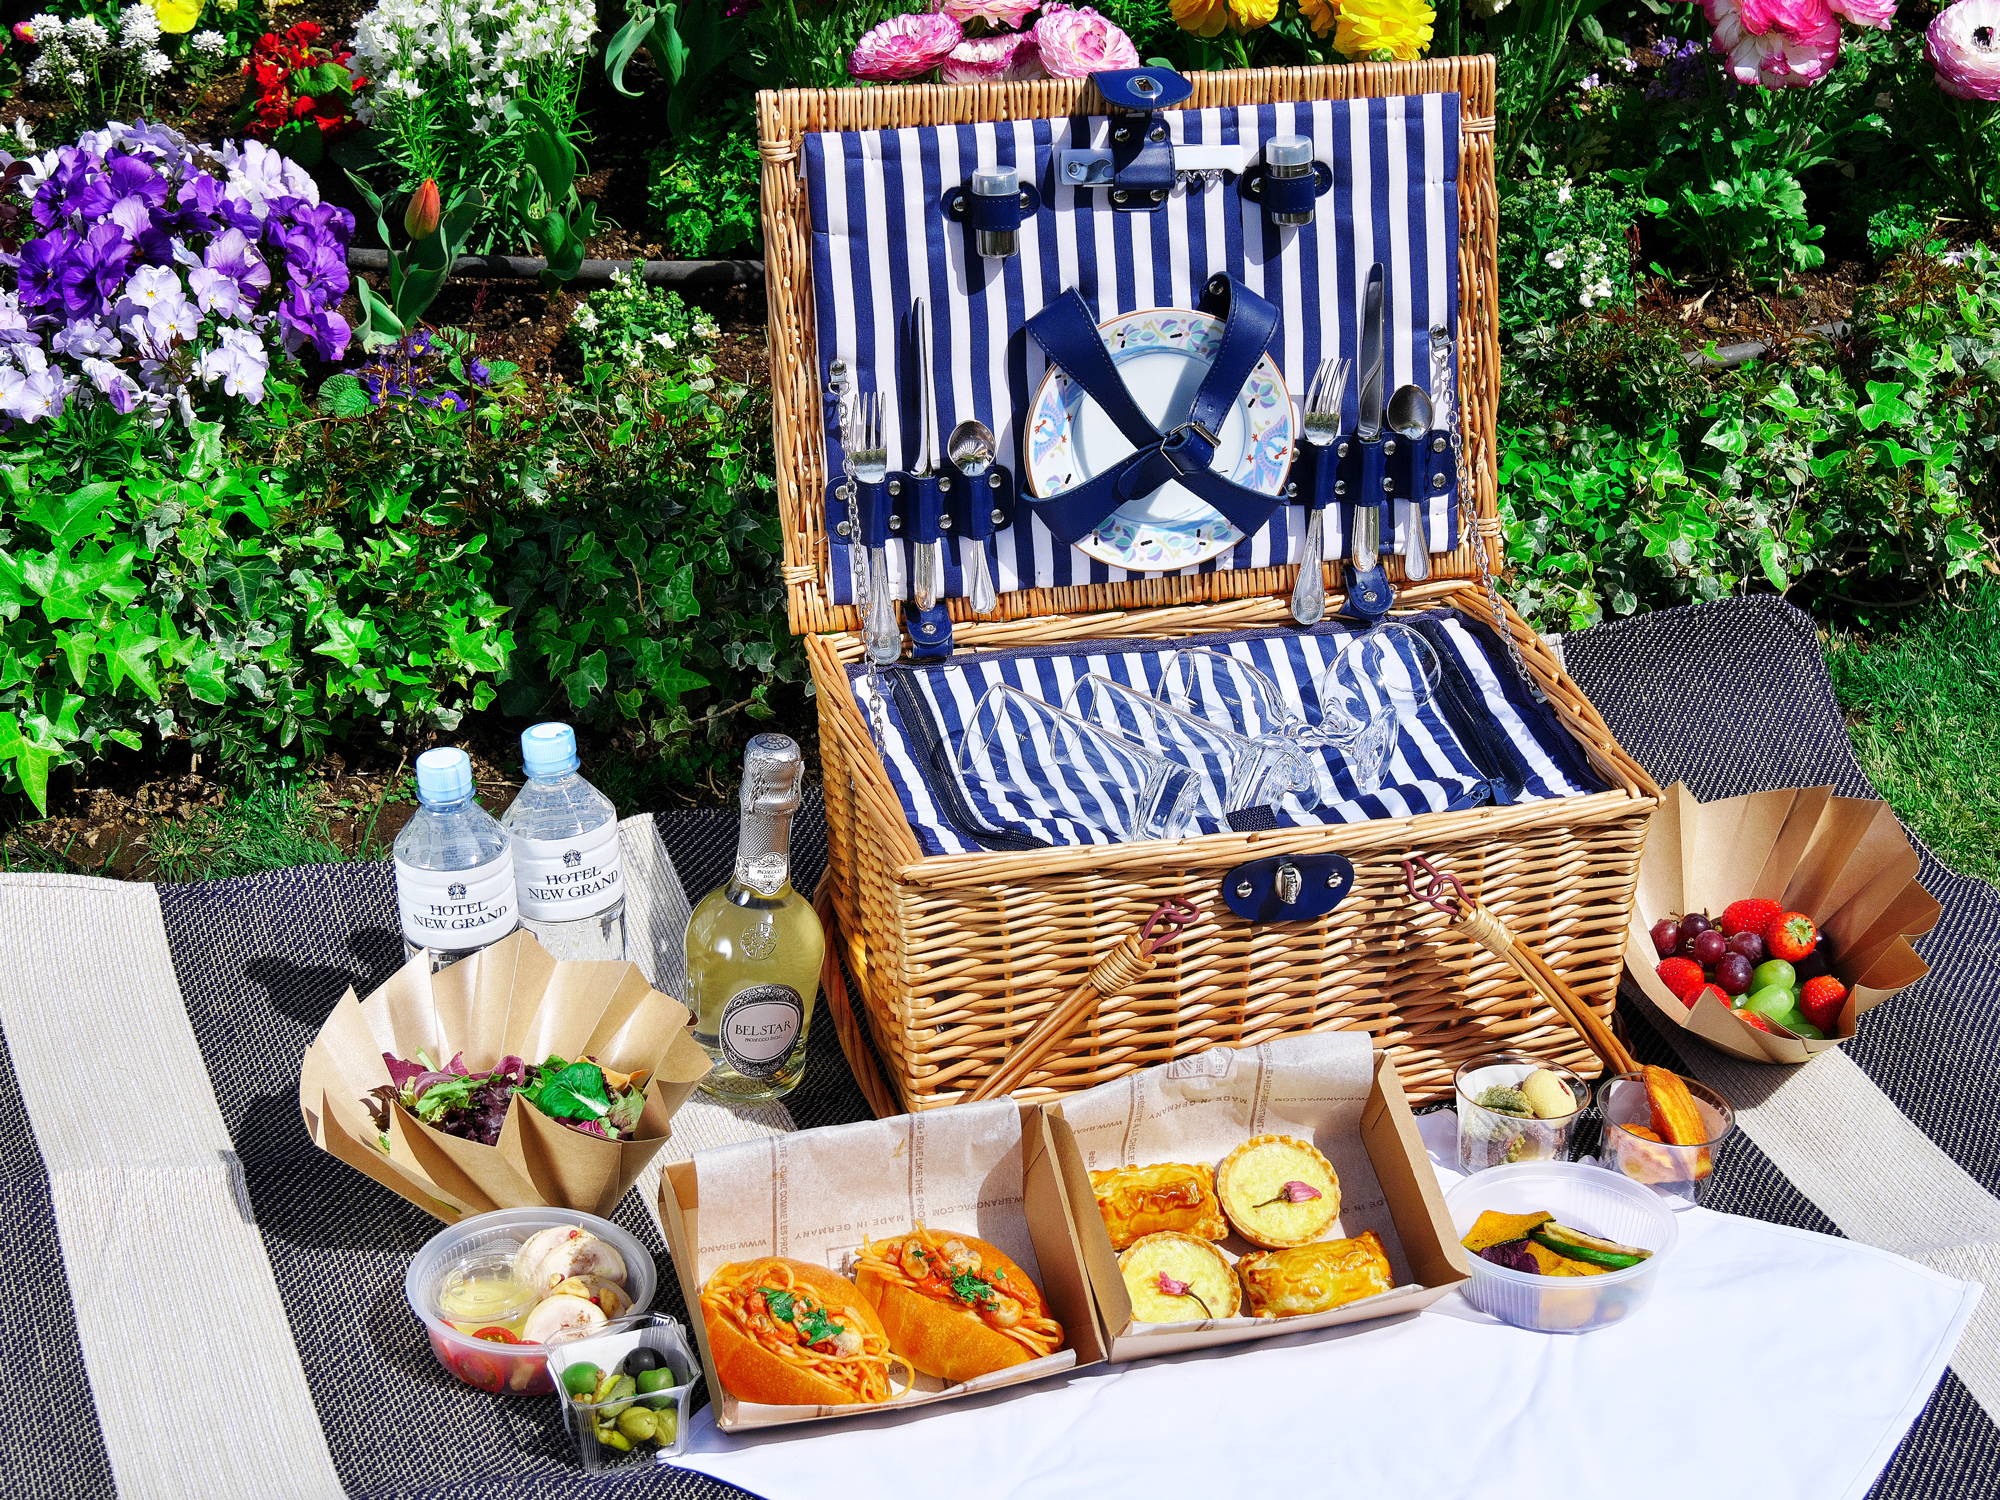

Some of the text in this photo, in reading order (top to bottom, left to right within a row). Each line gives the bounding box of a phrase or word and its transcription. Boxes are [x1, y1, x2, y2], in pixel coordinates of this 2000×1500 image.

[527, 868, 619, 901] NEW GRAND
[545, 865, 602, 886] HOTEL
[413, 904, 508, 930] NEW GRAND
[429, 900, 489, 917] HOTEL
[735, 1020, 792, 1036] BELSTAR
[1147, 1099, 1196, 1120] GERMANY
[1215, 1095, 1248, 1105] MADE
[915, 1135, 924, 1156] BAKE
[915, 1177, 924, 1195] THE
[779, 1190, 788, 1219] COMME
[779, 1221, 788, 1236] LES
[794, 1213, 904, 1240] MADE IN GERMANY
